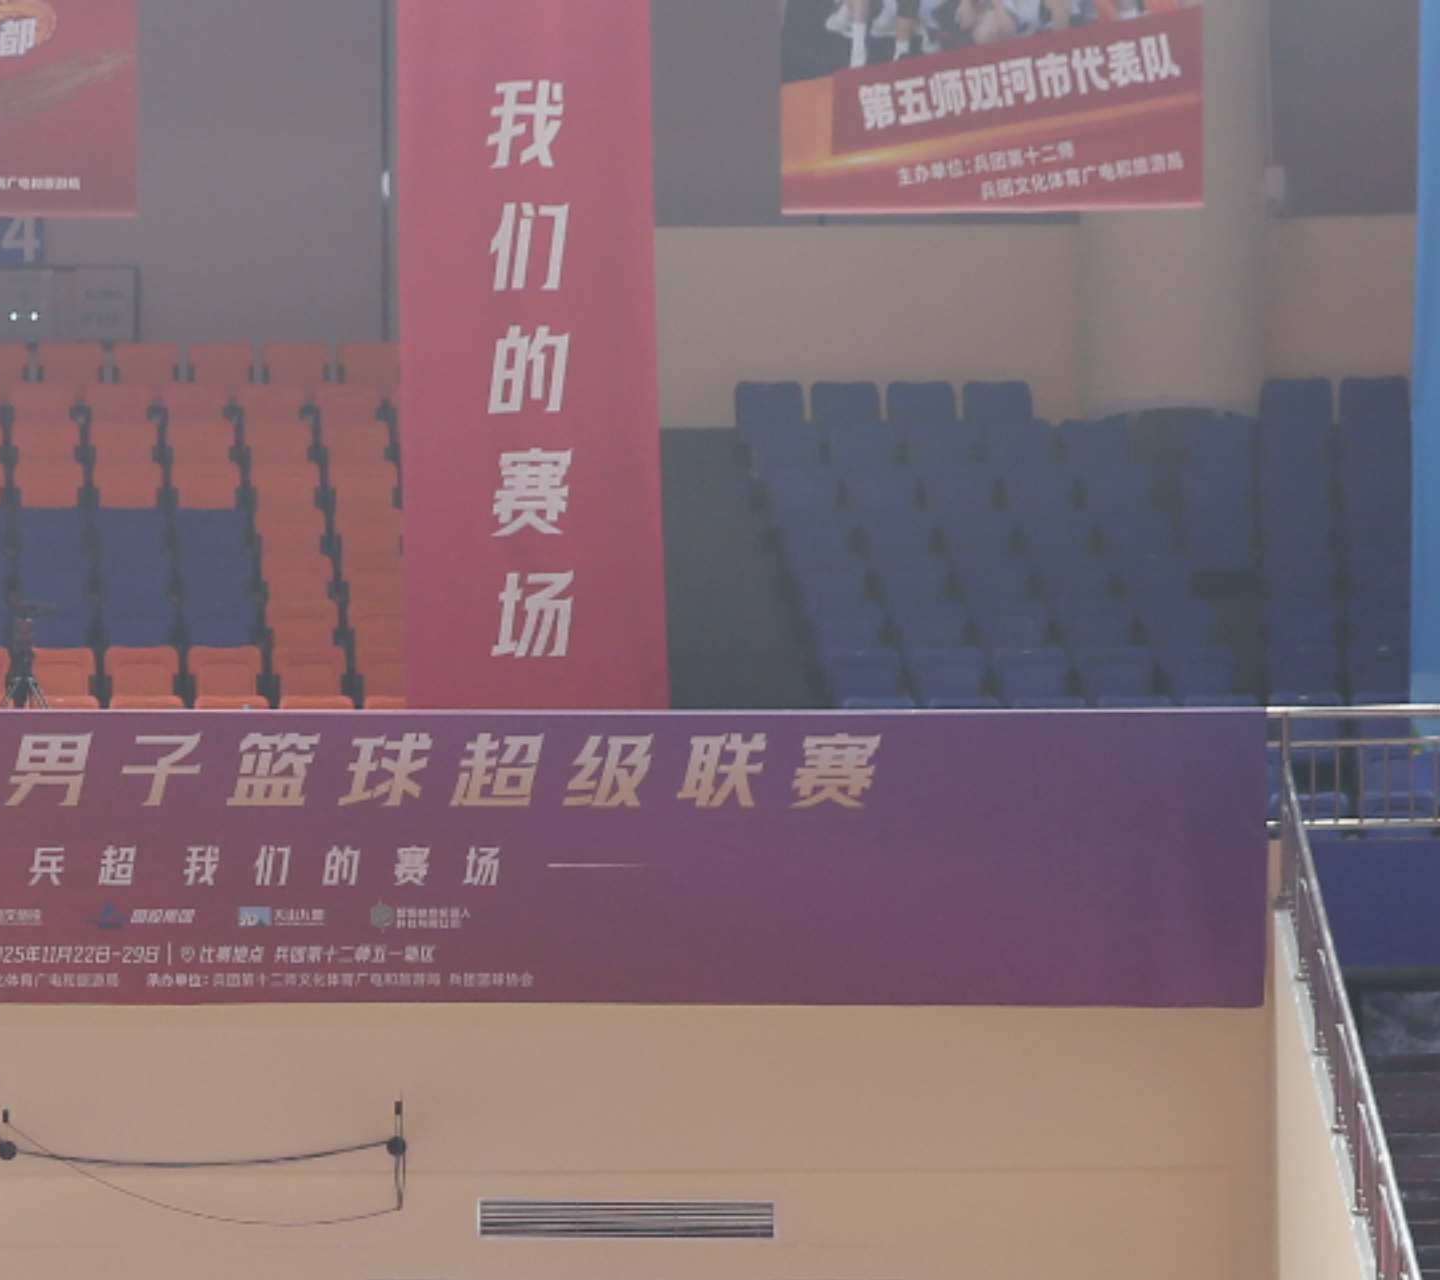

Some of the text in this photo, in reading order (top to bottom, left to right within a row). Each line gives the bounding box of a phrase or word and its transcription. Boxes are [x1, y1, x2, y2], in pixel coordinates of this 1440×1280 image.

[858, 32, 1182, 130] 第五师双河市代表队
[485, 80, 576, 664] 我们的赛场
[182, 845, 503, 888] 我们的赛场
